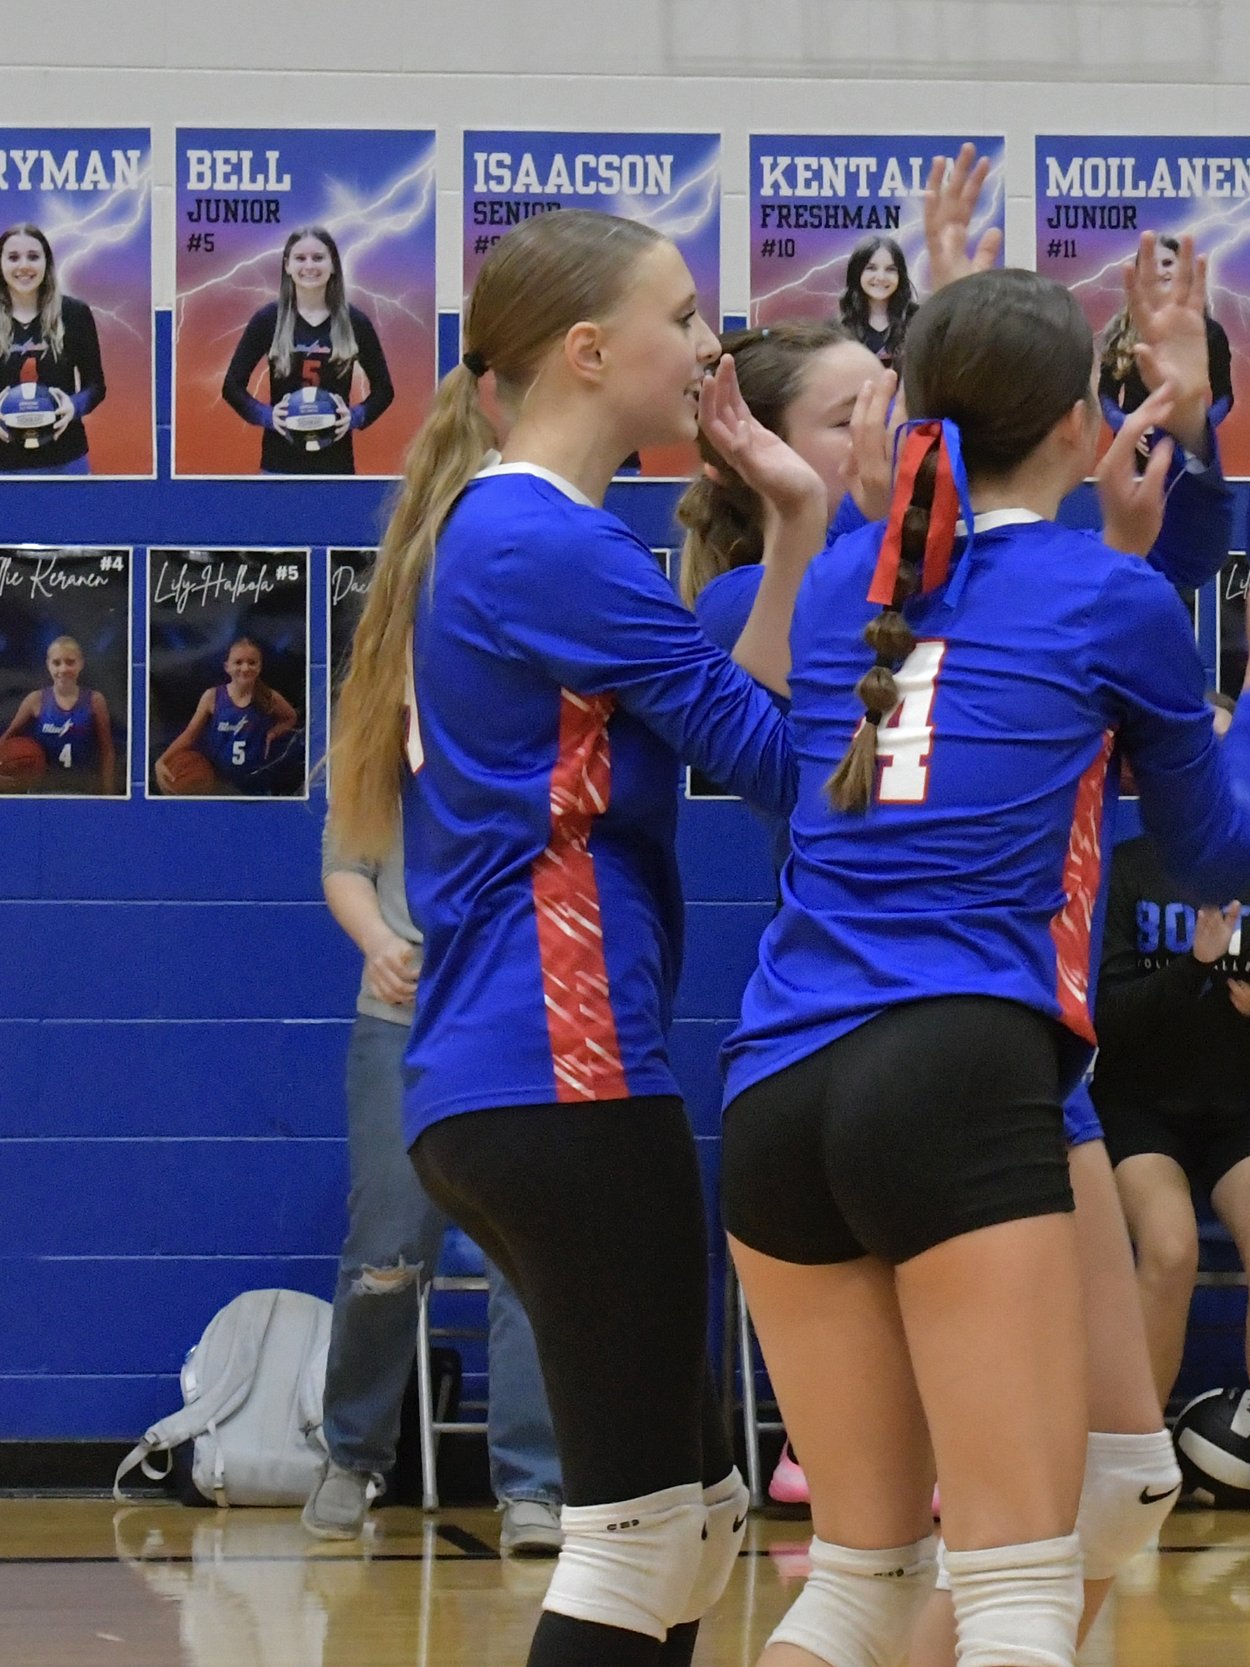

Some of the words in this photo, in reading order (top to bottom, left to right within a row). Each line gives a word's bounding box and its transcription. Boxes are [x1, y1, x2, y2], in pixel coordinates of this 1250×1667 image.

[0, 149, 141, 190] YMAN
[187, 150, 291, 191] BELL
[474, 152, 674, 195] ISAACSON
[187, 199, 281, 223] JUNIOR
[760, 204, 901, 229] FRESHMAN
[1047, 205, 1137, 230] JUNIOR
[187, 233, 215, 253] #5
[761, 238, 796, 258] #10
[1047, 239, 1077, 258] #11
[30, 555, 109, 599] Keranen
[100, 556, 124, 572] #4
[154, 560, 196, 614] Lily
[191, 561, 274, 607] Halkola
[275, 565, 299, 581] #5
[855, 638, 948, 804] 4
[58, 743, 72, 768] 4
[232, 741, 246, 766] 5
